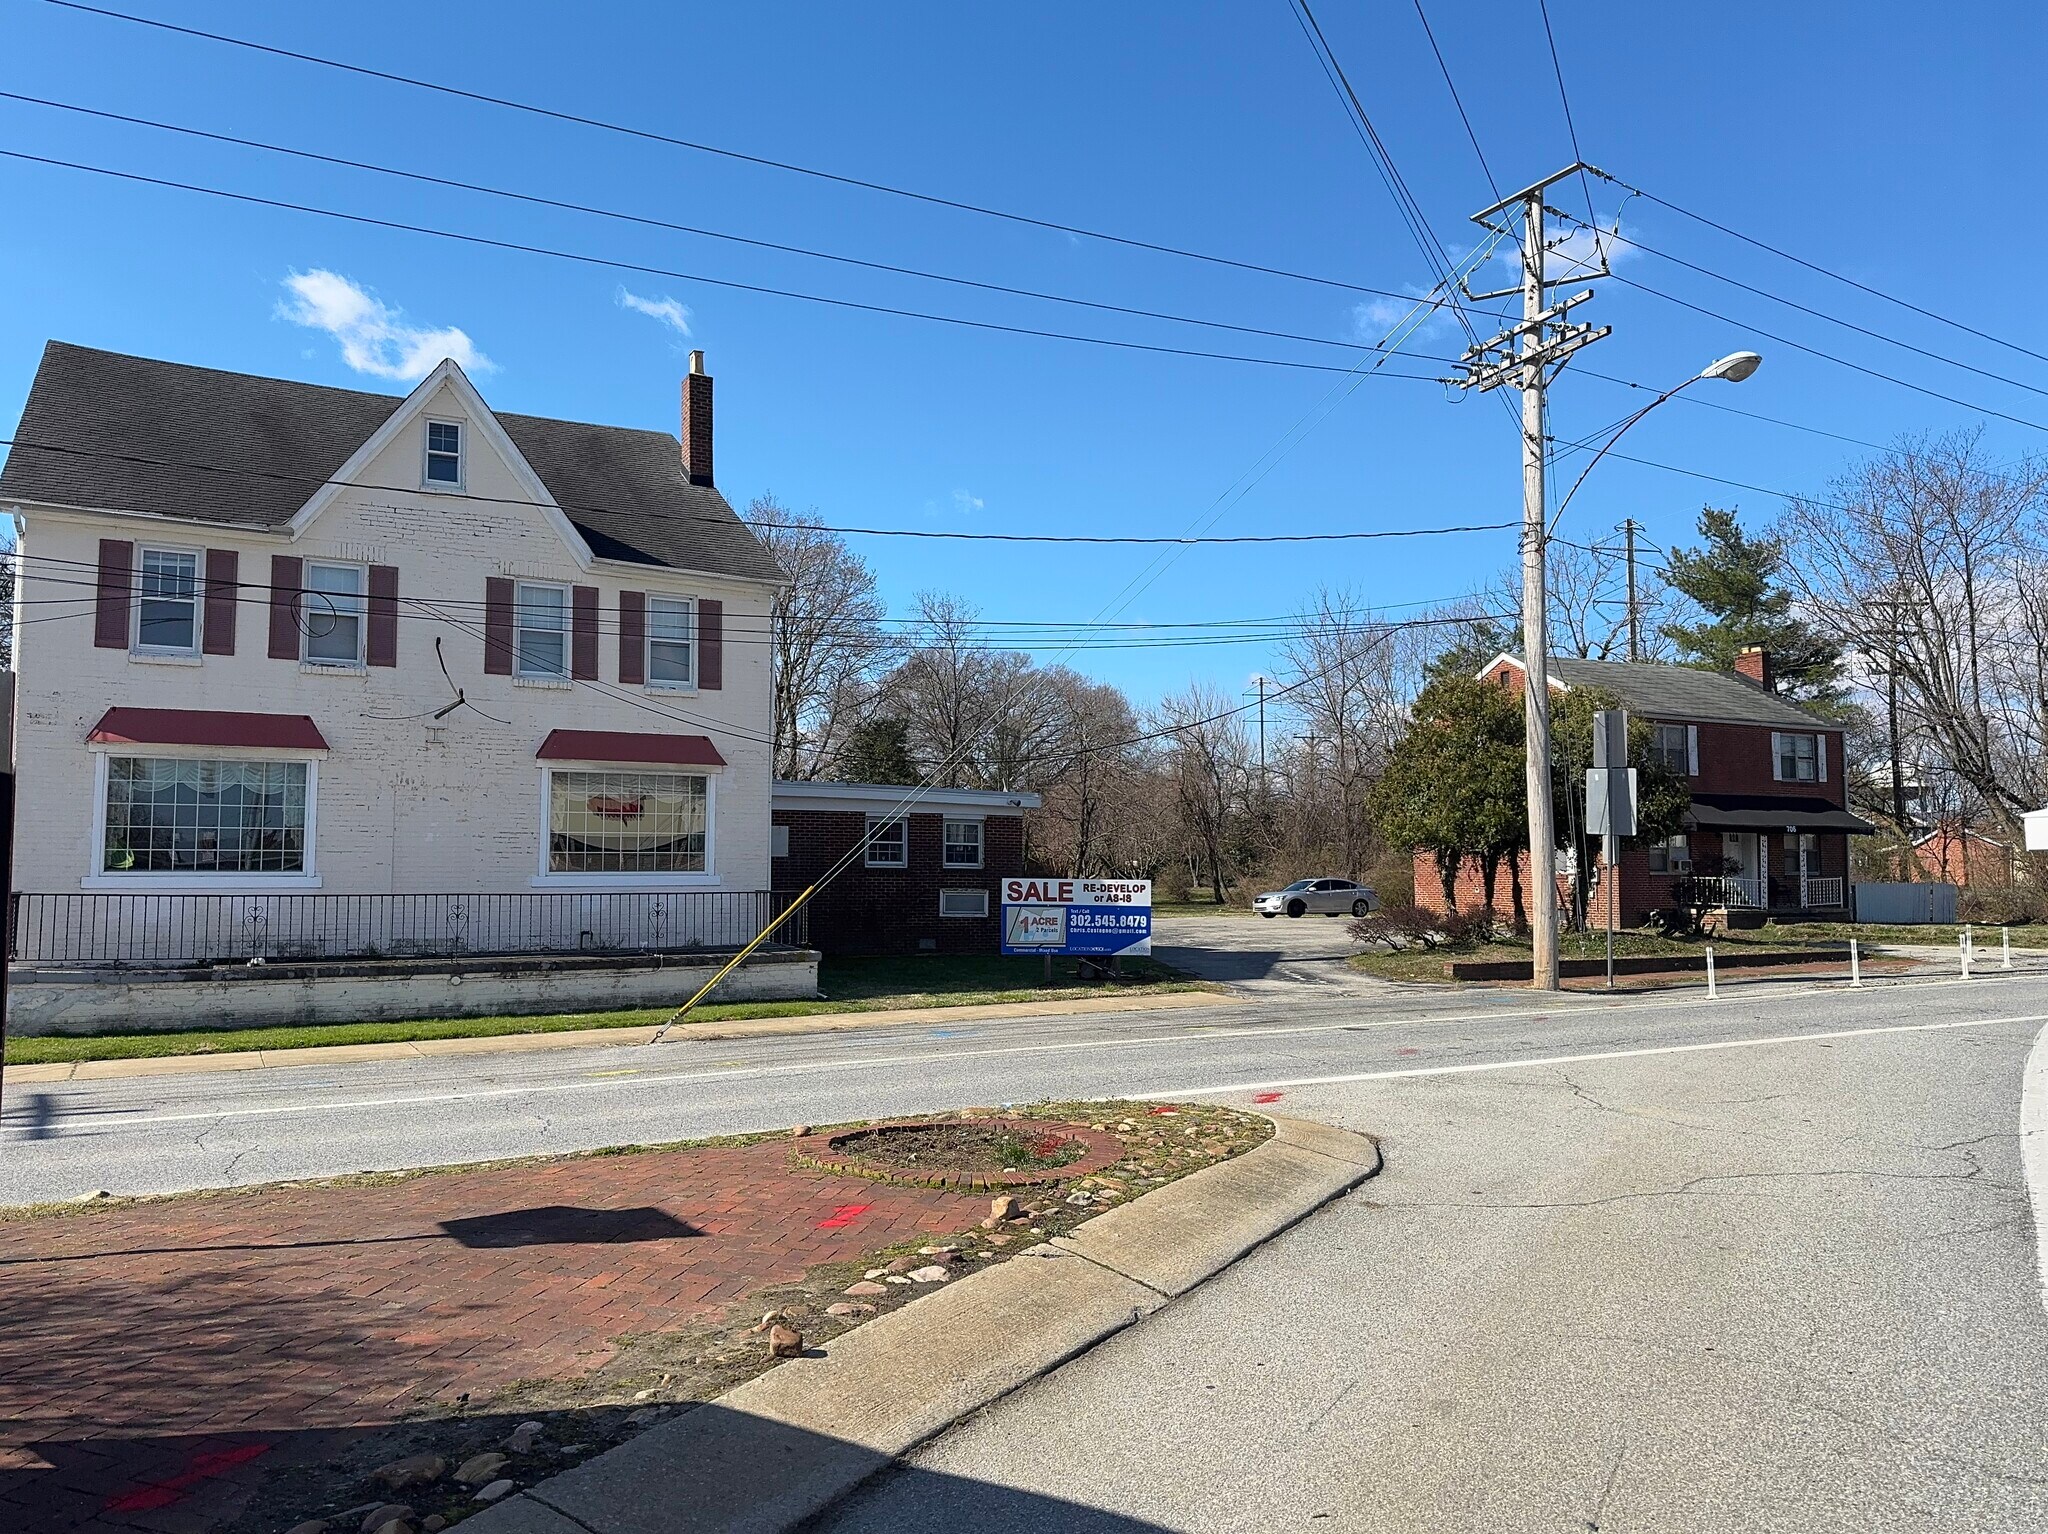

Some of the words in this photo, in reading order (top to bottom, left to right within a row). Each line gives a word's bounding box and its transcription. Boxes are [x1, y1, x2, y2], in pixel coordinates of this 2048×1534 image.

[1007, 881, 1074, 902] SALE
[1083, 883, 1146, 893] RE-DEVELOP
[1094, 895, 1104, 903] or
[1106, 894, 1132, 903] AS-IS
[1020, 916, 1029, 933] 1
[1031, 917, 1058, 926] ACRE
[1070, 915, 1147, 927] 302.545.8479
